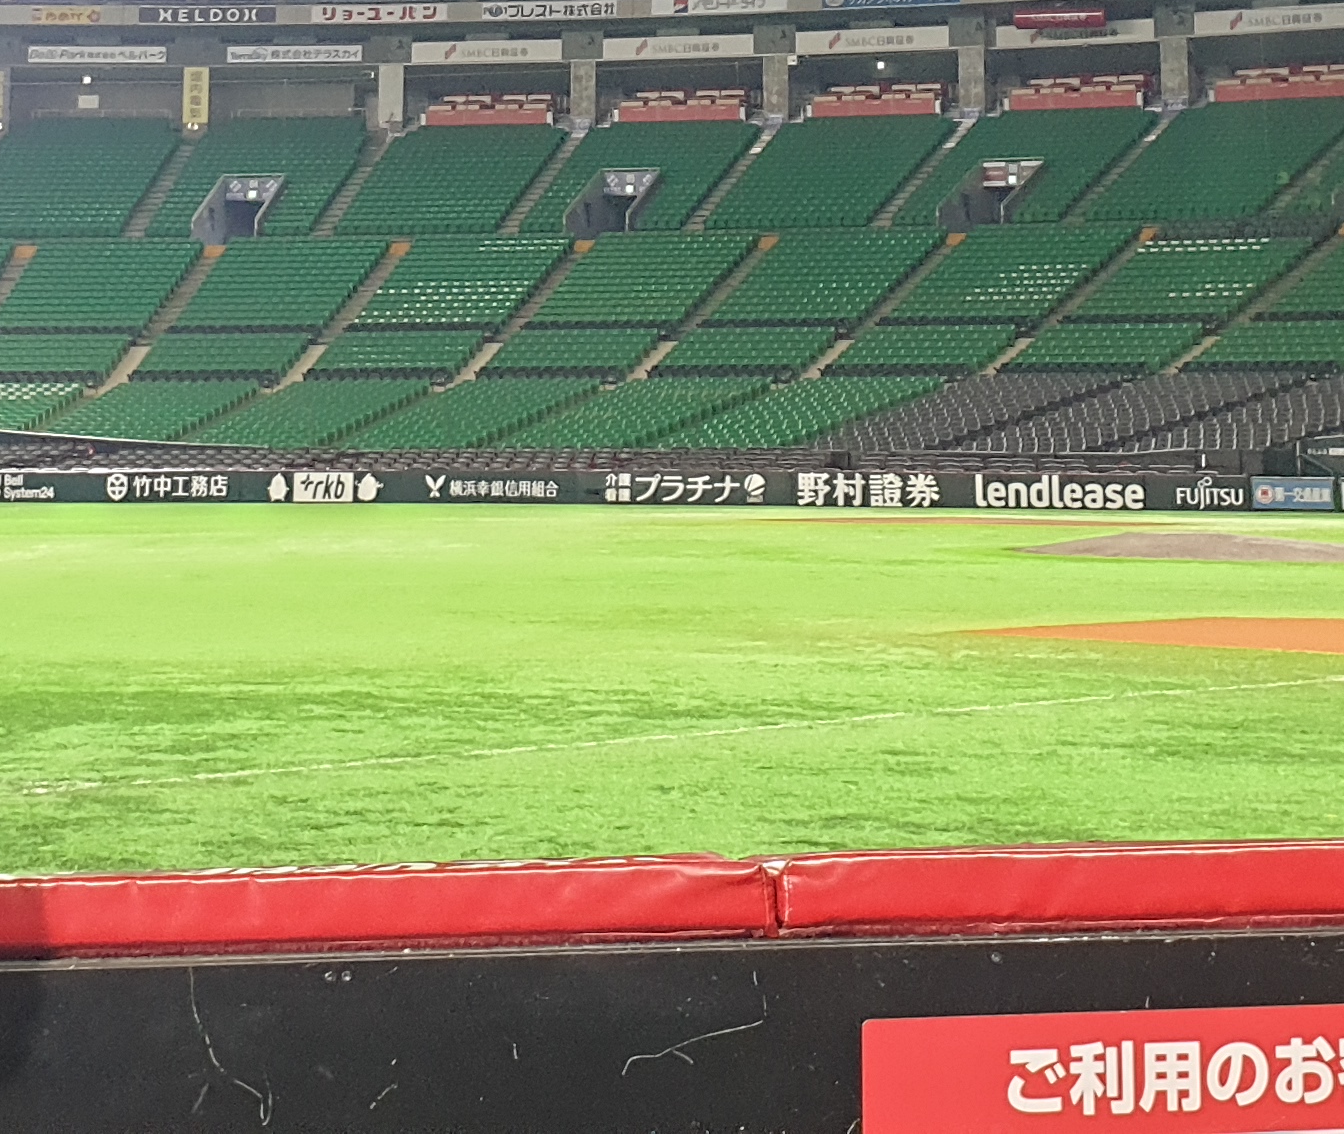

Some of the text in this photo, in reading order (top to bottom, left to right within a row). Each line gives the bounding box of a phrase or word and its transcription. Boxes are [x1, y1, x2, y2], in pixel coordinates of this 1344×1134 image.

[132, 475, 229, 498] 竹中工務店
[449, 479, 559, 498] 横浜幸銀信用組合
[635, 475, 741, 501] プラチナ
[796, 472, 941, 508] 野村證券
[974, 473, 1145, 509] lendlease
[1176, 482, 1244, 509] FUJITSU
